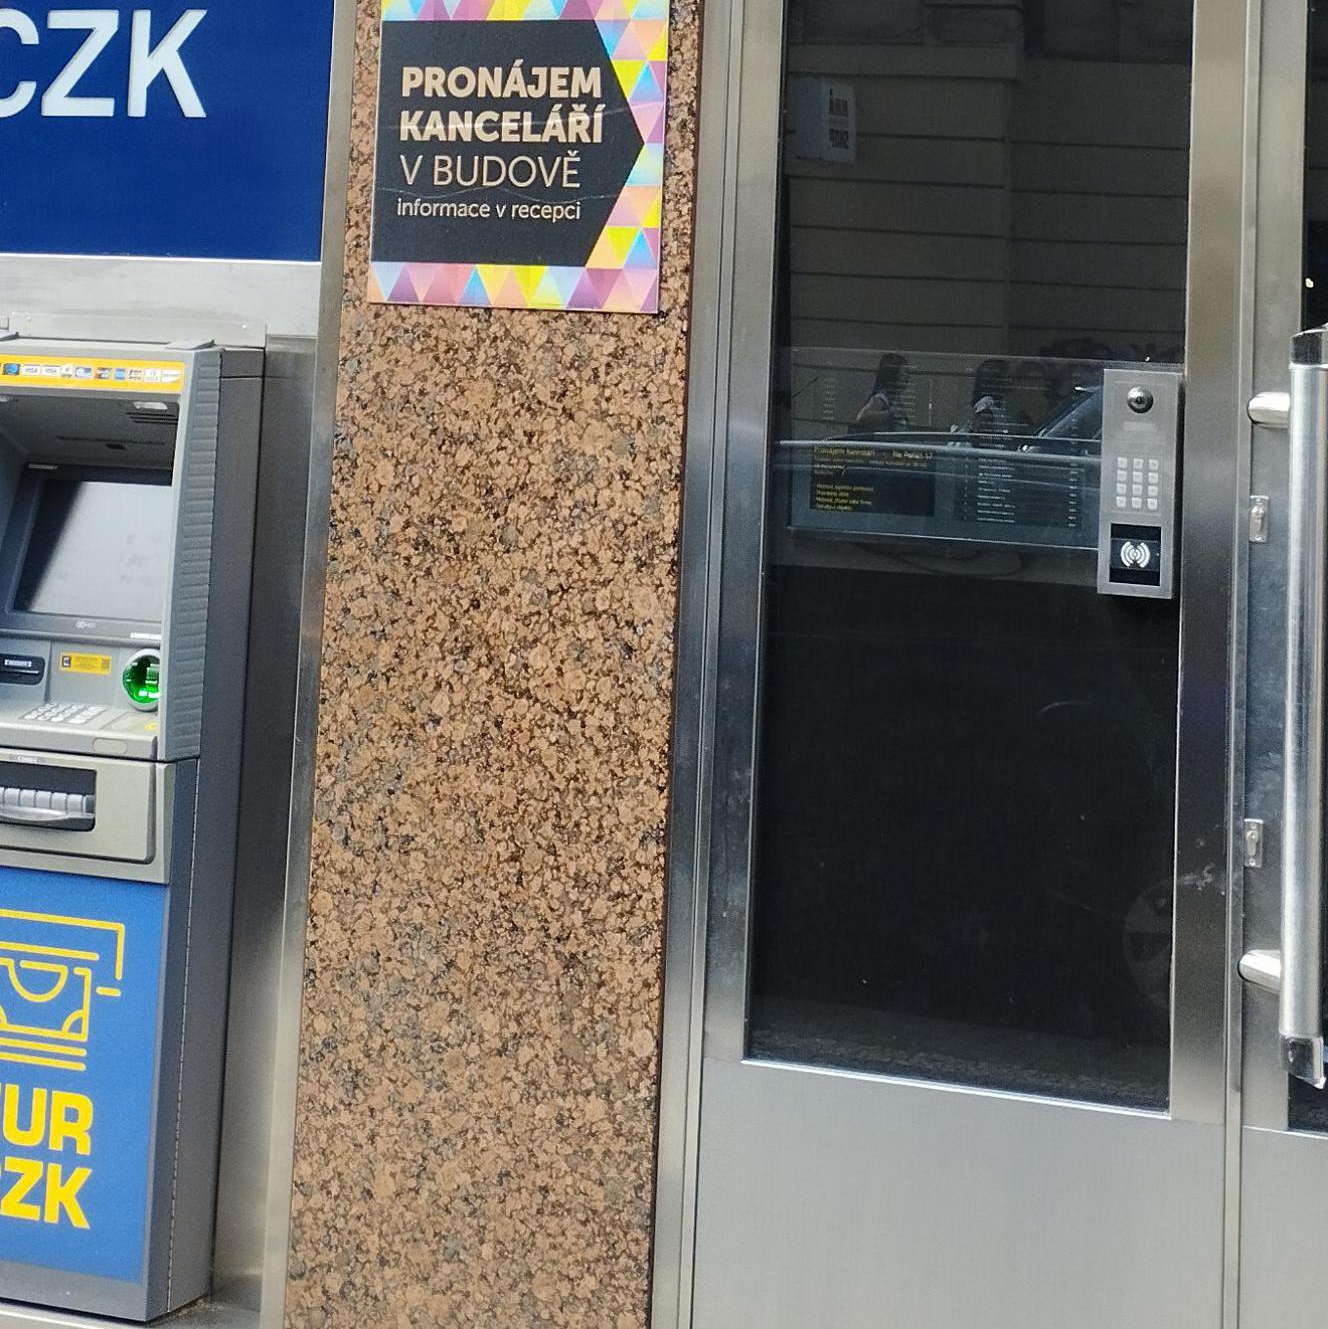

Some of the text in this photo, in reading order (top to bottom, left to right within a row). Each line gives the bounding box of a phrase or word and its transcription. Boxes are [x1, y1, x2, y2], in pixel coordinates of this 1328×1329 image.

[401, 59, 602, 99] PRONÁJEM
[399, 103, 607, 144] KANCELÁŘÍ
[399, 150, 581, 189] V BUDOVĚ
[397, 197, 581, 223] informace v recepci
